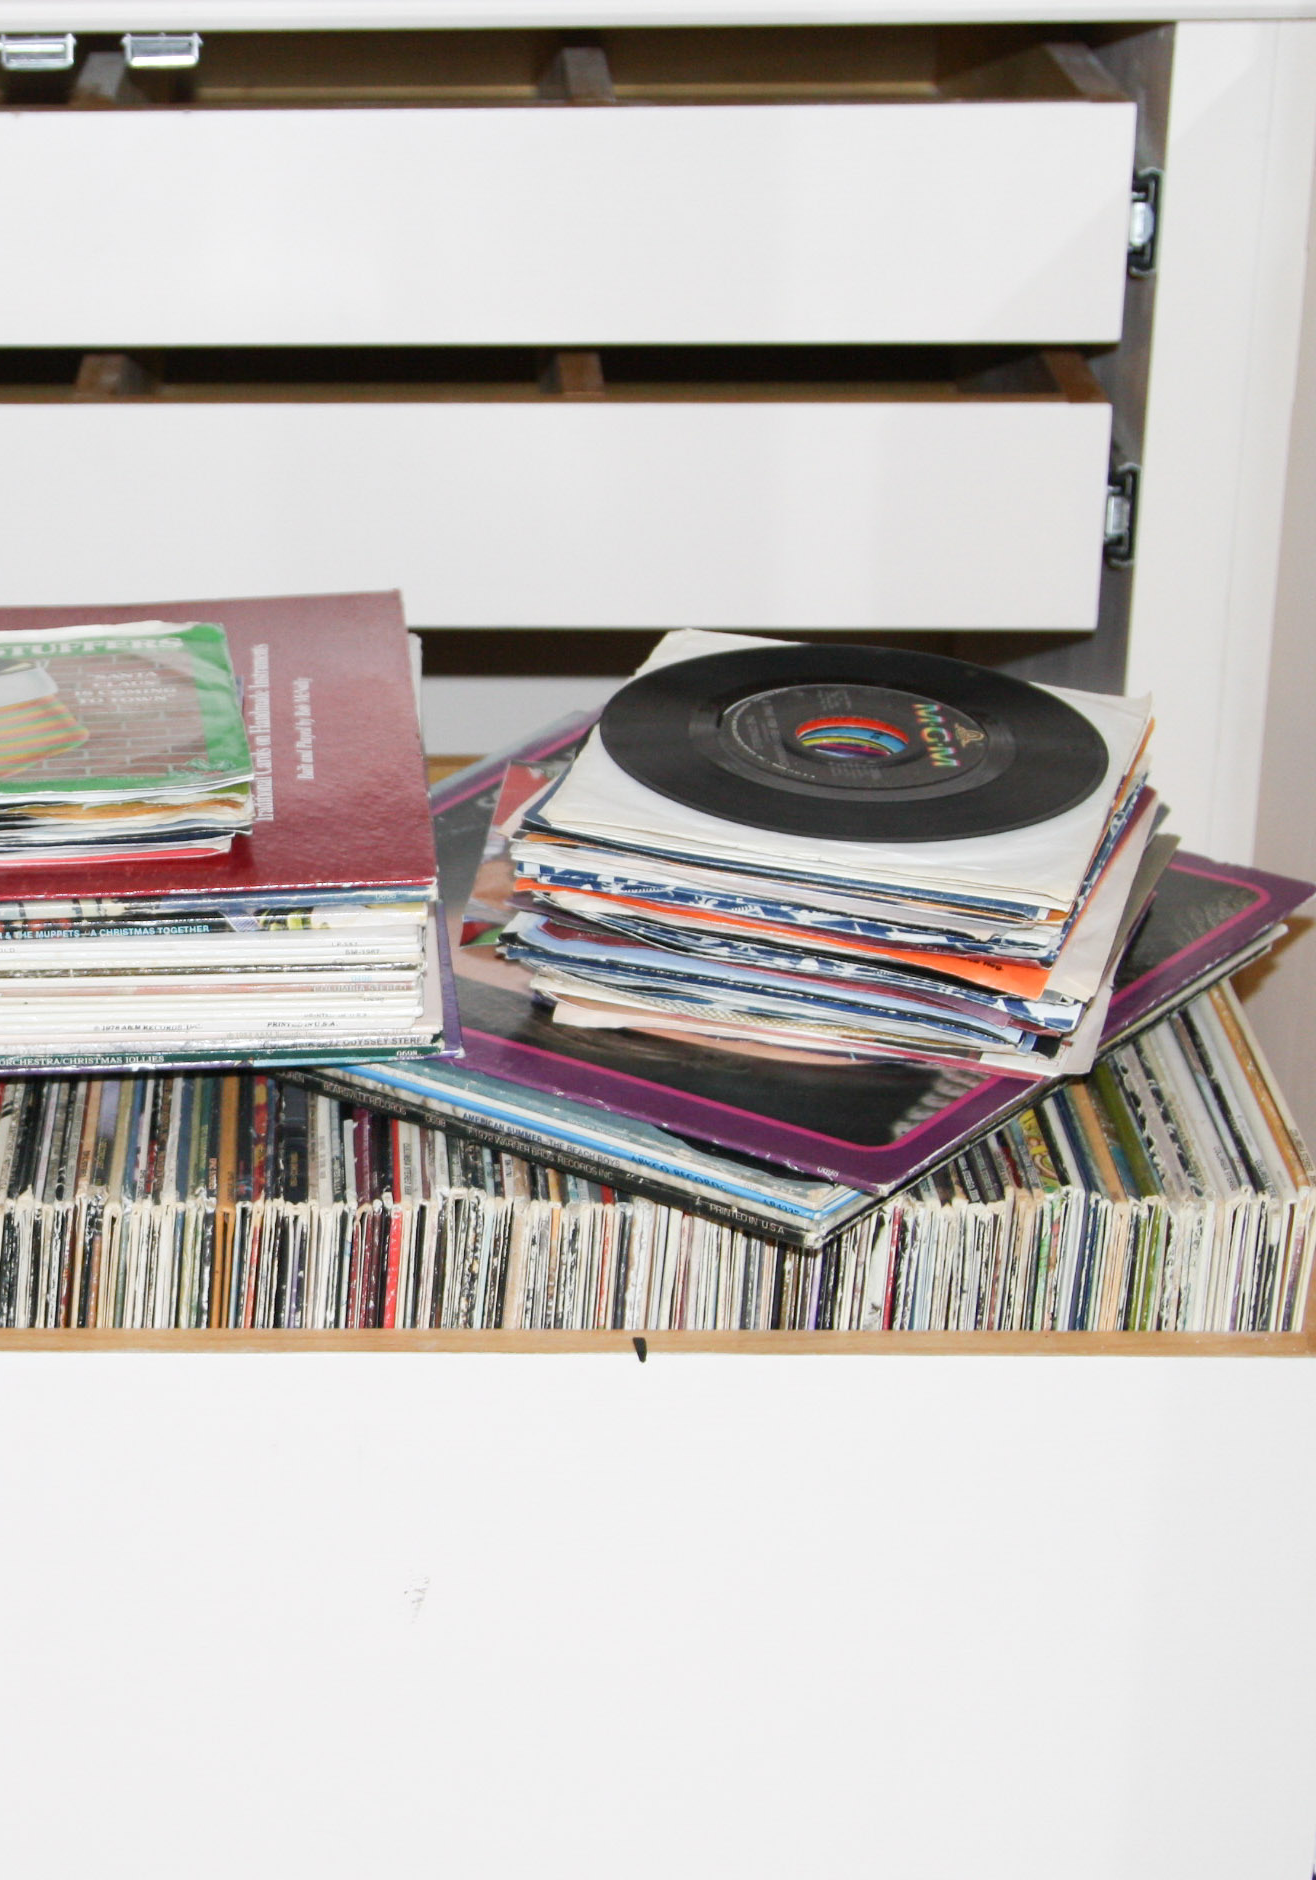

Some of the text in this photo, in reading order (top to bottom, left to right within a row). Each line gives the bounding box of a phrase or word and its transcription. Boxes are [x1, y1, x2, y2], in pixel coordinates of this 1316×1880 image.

[249, 691, 272, 734] Handmade
[251, 747, 273, 775] Carols
[255, 776, 274, 821] Traditional
[5, 931, 12, 939] &
[14, 931, 33, 939] THE
[36, 929, 80, 938] MUPPETS
[100, 927, 155, 937] CHRISTMAS
[156, 925, 210, 934] TOGETHER
[125, 1055, 165, 1064] JOLLIES
[343, 1038, 388, 1046] ODYSSEY
[463, 1113, 621, 1169] AMERICAN SUMMER THE BEACH BOYS
[557, 1155, 598, 1178] RECORDS
[709, 1203, 749, 1224] PRINTED
[747, 1215, 758, 1227] IN
